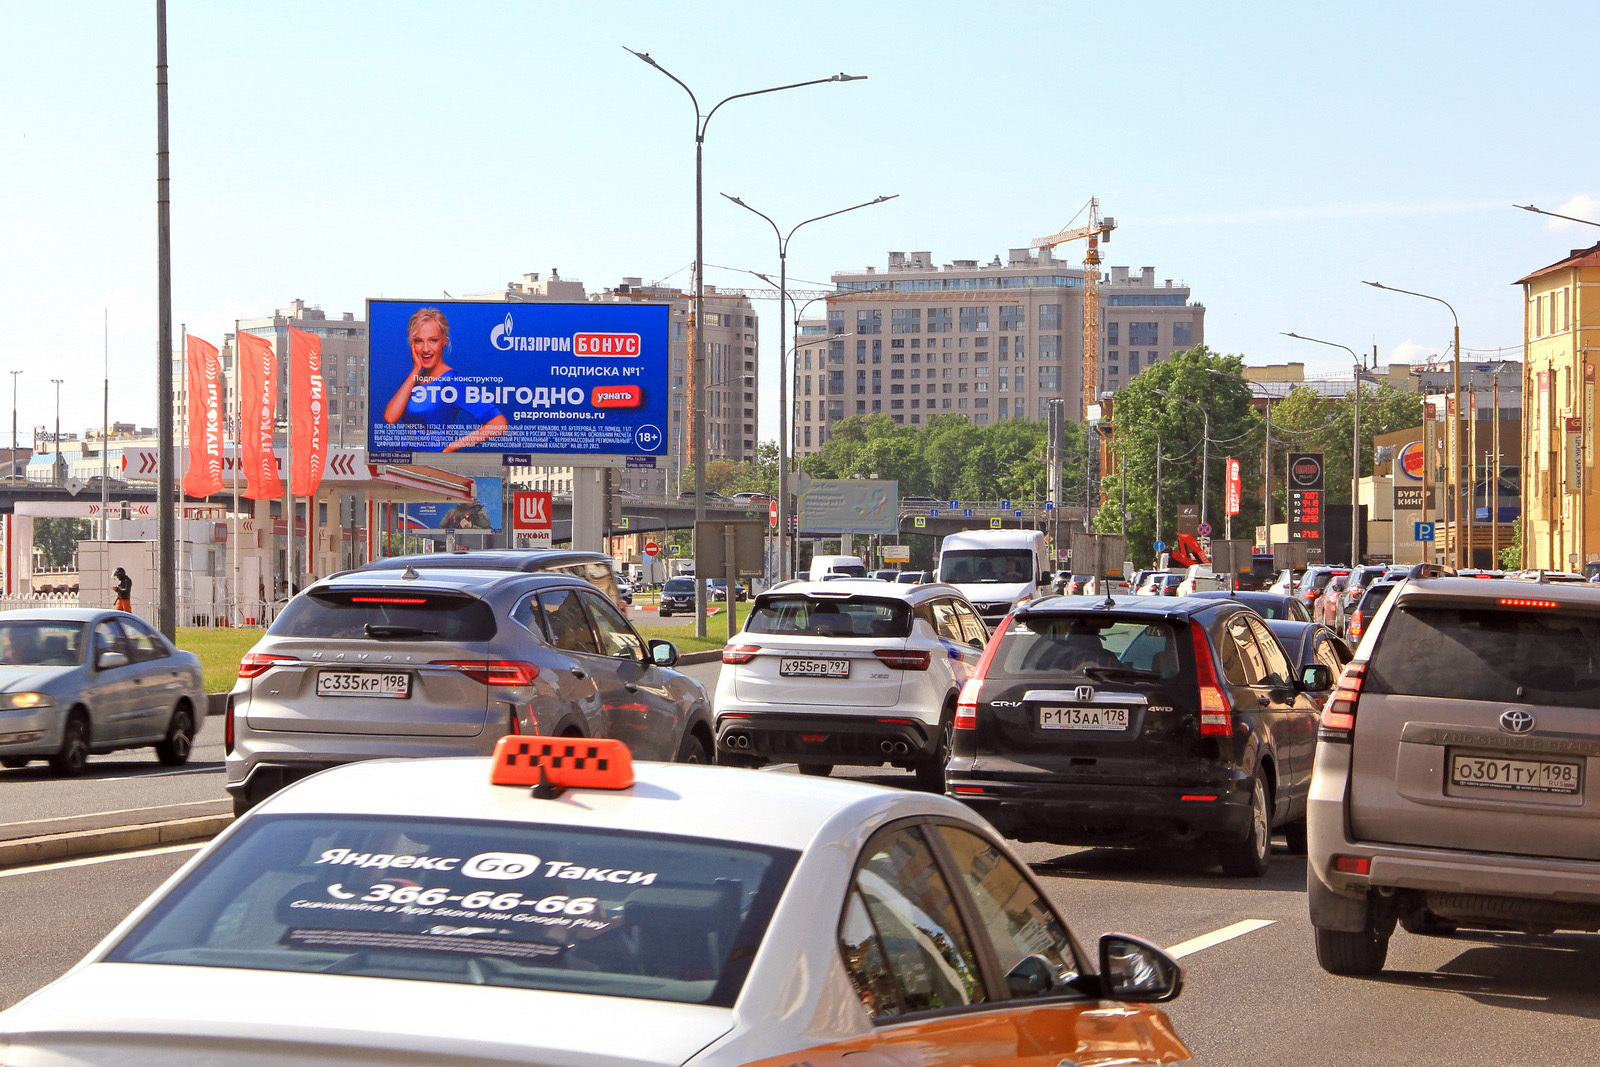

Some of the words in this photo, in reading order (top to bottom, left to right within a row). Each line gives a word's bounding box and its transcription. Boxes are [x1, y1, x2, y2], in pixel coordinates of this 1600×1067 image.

[514, 336, 570, 352] ГАЗПРОМ
[578, 338, 636, 352] БОНУС
[413, 374, 504, 383] Подписка-конструктор
[550, 366, 619, 378] ПОДПИСКА
[411, 386, 458, 404] ЭТО
[465, 386, 585, 408] ВЫГОДНО
[597, 392, 632, 402] узнать
[206, 383, 218, 456] ЛУКОЙЛ
[260, 380, 272, 452] ЛУКОЙЛ
[310, 374, 322, 450] ЛУКОЙЛ
[514, 410, 605, 420] gazprombonus.ru
[638, 432, 658, 442] 18+
[312, 652, 412, 661] HAVAL
[785, 661, 826, 672] Х955РВ
[829, 662, 845, 670] 797
[323, 675, 379, 690] С335КР
[384, 675, 404, 688] 198
[1044, 710, 1099, 725] Р113АА
[1104, 710, 1125, 722] 178
[1434, 732, 1473, 744] LAND
[1478, 735, 1543, 749] CRUISER
[1460, 761, 1537, 783] О301ТУ
[1543, 765, 1572, 781] 198
[314, 848, 461, 871] Яндекс
[544, 860, 658, 885] Такси
[361, 884, 598, 915] 366-66-66
[290, 900, 385, 912] Скачивайте
[396, 905, 433, 916] App
[432, 907, 478, 918] Store
[478, 912, 512, 920] или
[512, 913, 572, 926] Google
[566, 918, 610, 930] Play
